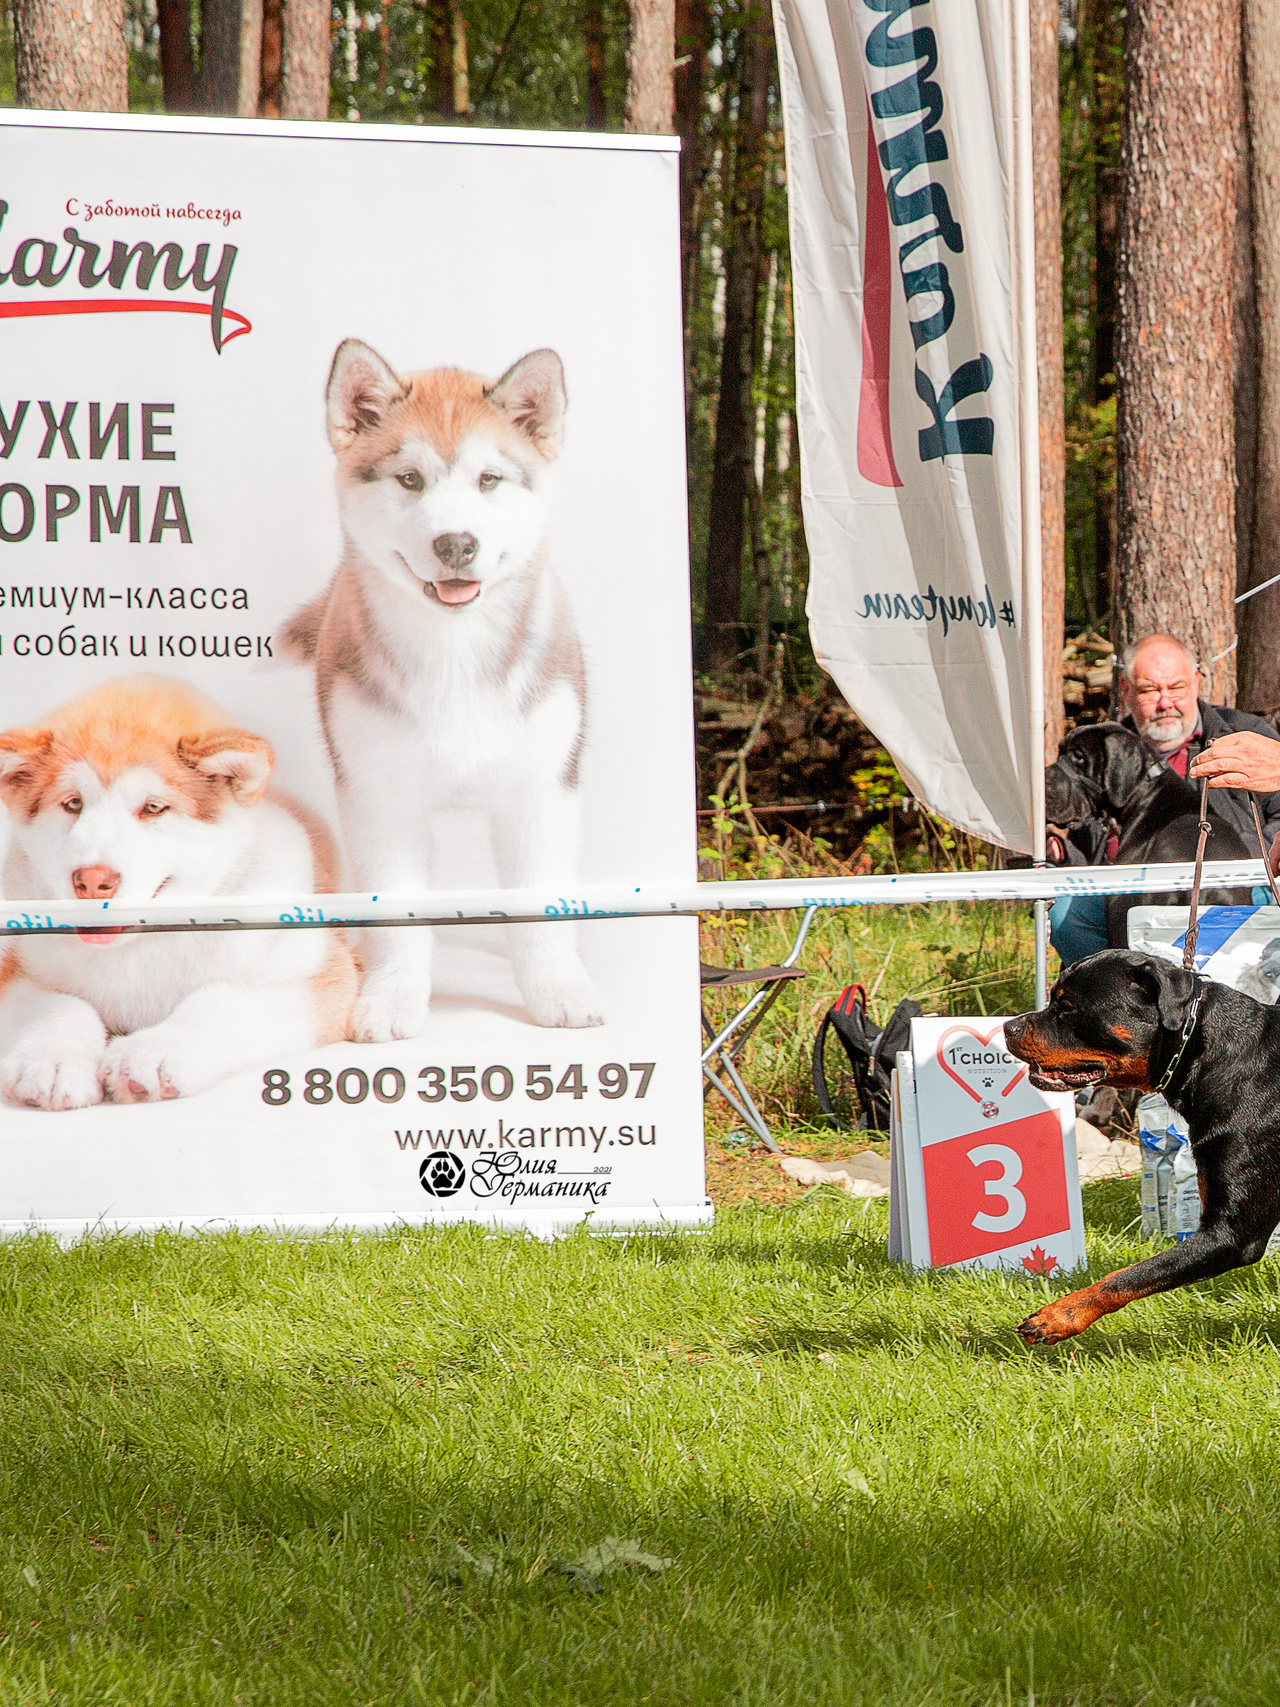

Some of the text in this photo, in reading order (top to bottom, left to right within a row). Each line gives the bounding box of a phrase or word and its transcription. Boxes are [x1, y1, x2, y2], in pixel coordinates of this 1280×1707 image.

[66, 198, 242, 227] С заботой навсегда
[13, 625, 119, 657] собак
[158, 634, 274, 658] кошек
[261, 1062, 657, 1106] 8 800 350 54 97
[394, 1119, 658, 1153] www.karmy.su
[966, 1143, 1027, 1233] 3
